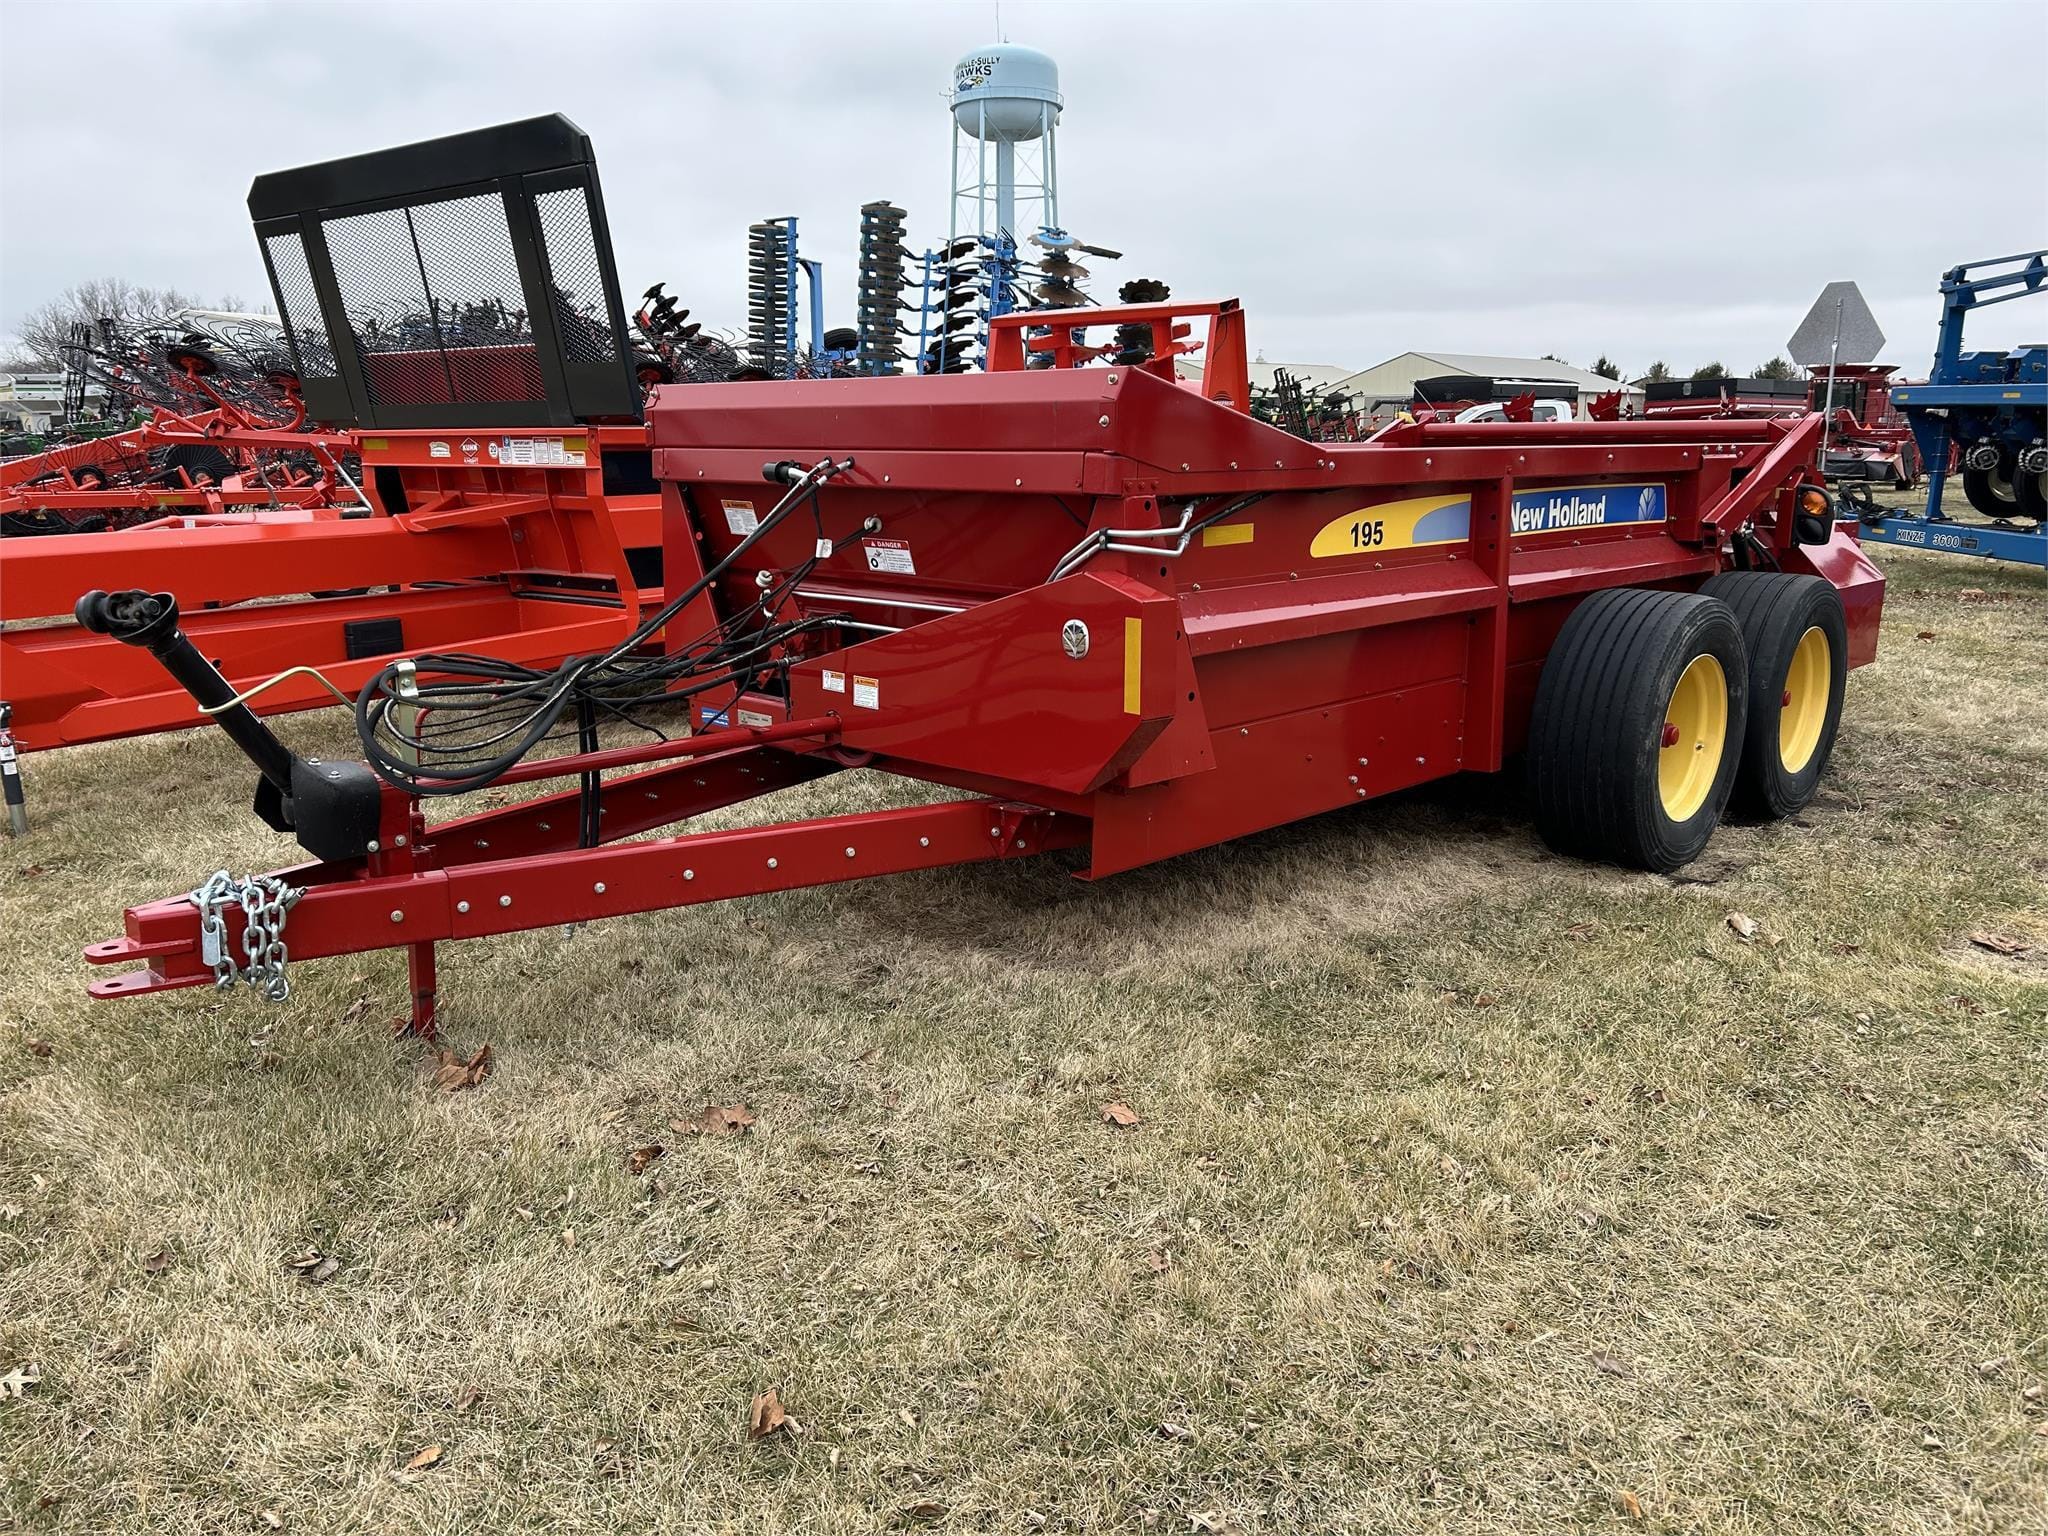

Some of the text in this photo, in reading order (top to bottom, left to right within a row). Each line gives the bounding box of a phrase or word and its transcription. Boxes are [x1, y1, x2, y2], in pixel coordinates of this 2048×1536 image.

[956, 65, 992, 80] HAWKS
[1511, 495, 1606, 532] New Holland
[1350, 521, 1384, 547] 195
[1896, 528, 1926, 544] KINZE
[1932, 533, 1960, 549] 3600
